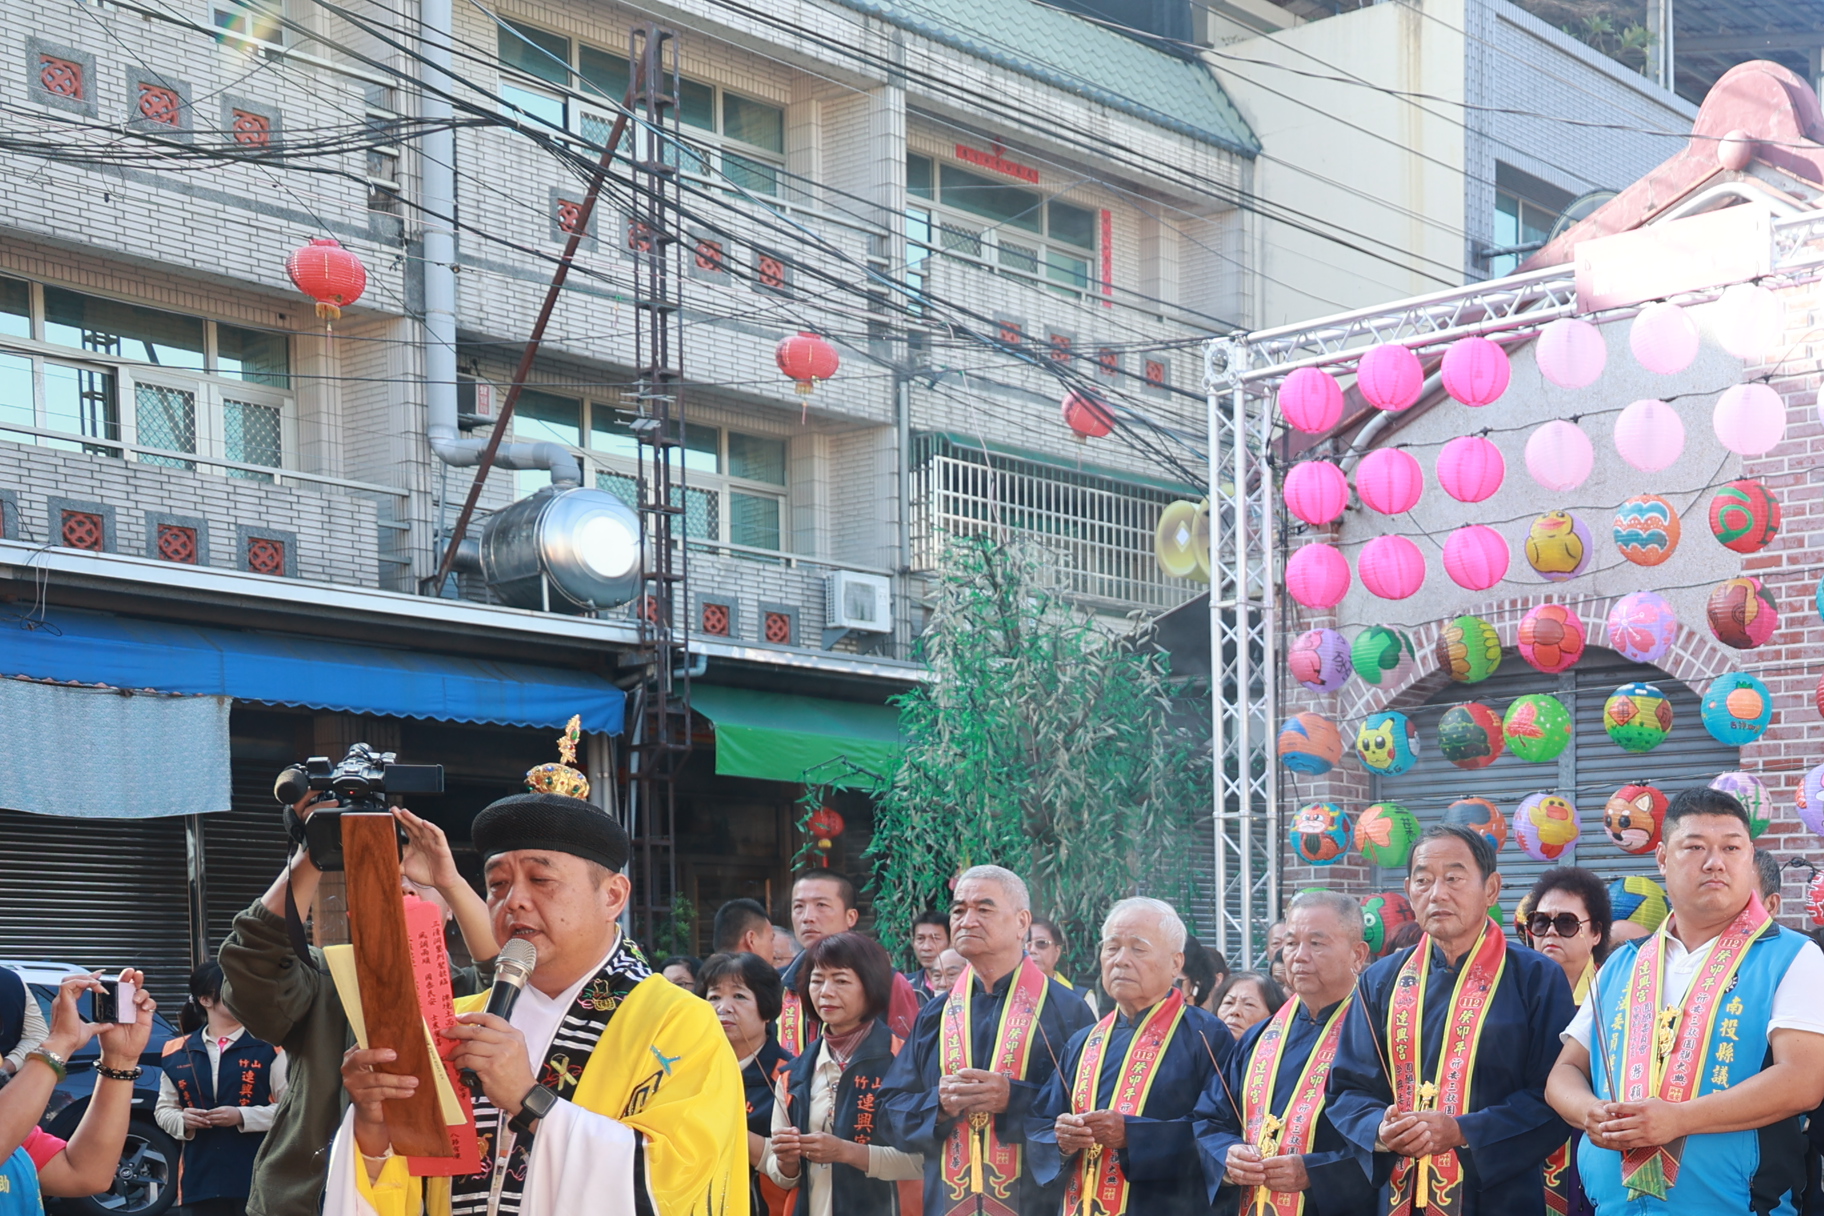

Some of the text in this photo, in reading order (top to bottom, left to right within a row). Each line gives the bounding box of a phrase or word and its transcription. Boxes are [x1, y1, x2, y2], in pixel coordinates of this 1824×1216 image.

[1722, 938, 1740, 948] 112
[1636, 960, 1652, 1003] 連興宮
[1701, 950, 1732, 991] 癸卯年
[1462, 998, 1481, 1007] 112
[1003, 1018, 1028, 1067] 112 癸卯年
[1395, 1010, 1411, 1060] 連興宮
[1453, 1010, 1475, 1056] 癸卯年
[948, 1034, 962, 1076] 連興宮
[1136, 1051, 1154, 1060] 112
[853, 1074, 882, 1090] 竹山
[1077, 1065, 1092, 1108] 連興宮
[1123, 1062, 1149, 1101] 癸卯年
[1250, 1059, 1267, 1104] 連興宮
[1304, 1062, 1330, 1102] 癸卯年
[853, 1093, 876, 1145] 連興宮
